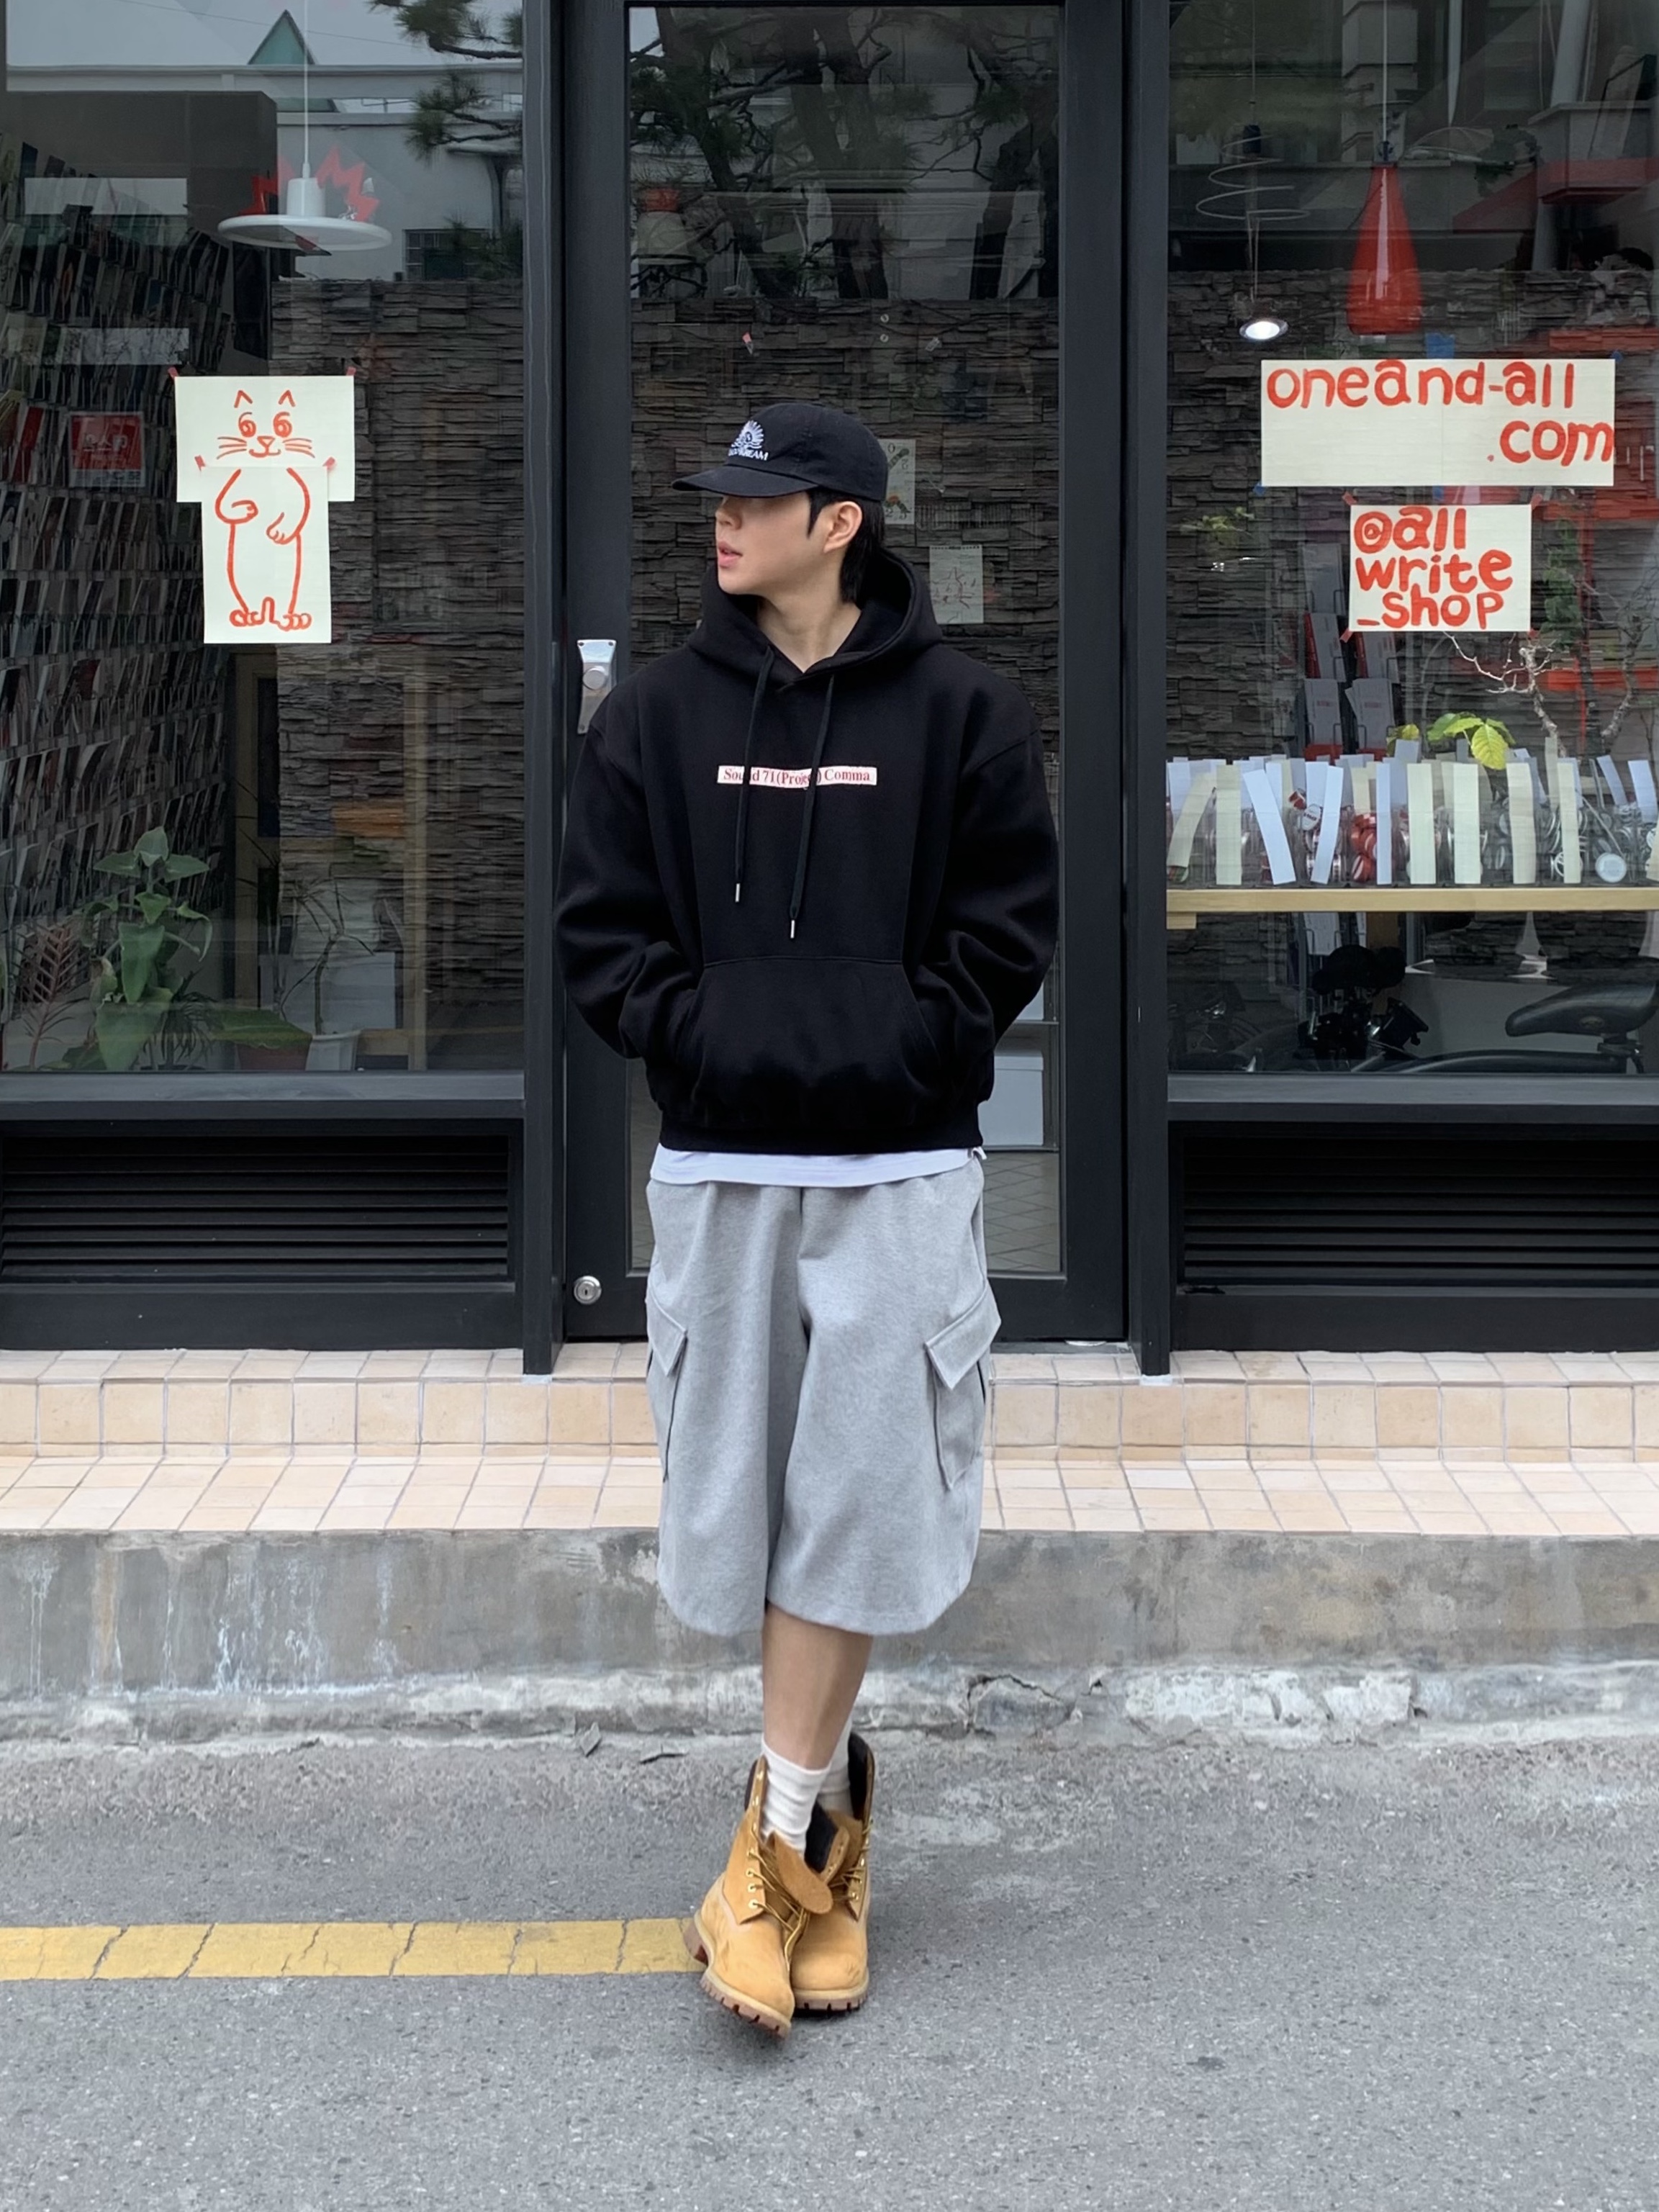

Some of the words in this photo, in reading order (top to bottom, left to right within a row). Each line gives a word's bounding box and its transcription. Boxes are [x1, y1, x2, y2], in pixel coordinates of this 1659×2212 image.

[1267, 360, 1574, 409] oneand-all
[1486, 420, 1614, 467] .com
[1353, 505, 1467, 554] @all
[1355, 549, 1514, 595] write
[824, 768, 870, 782] Comma
